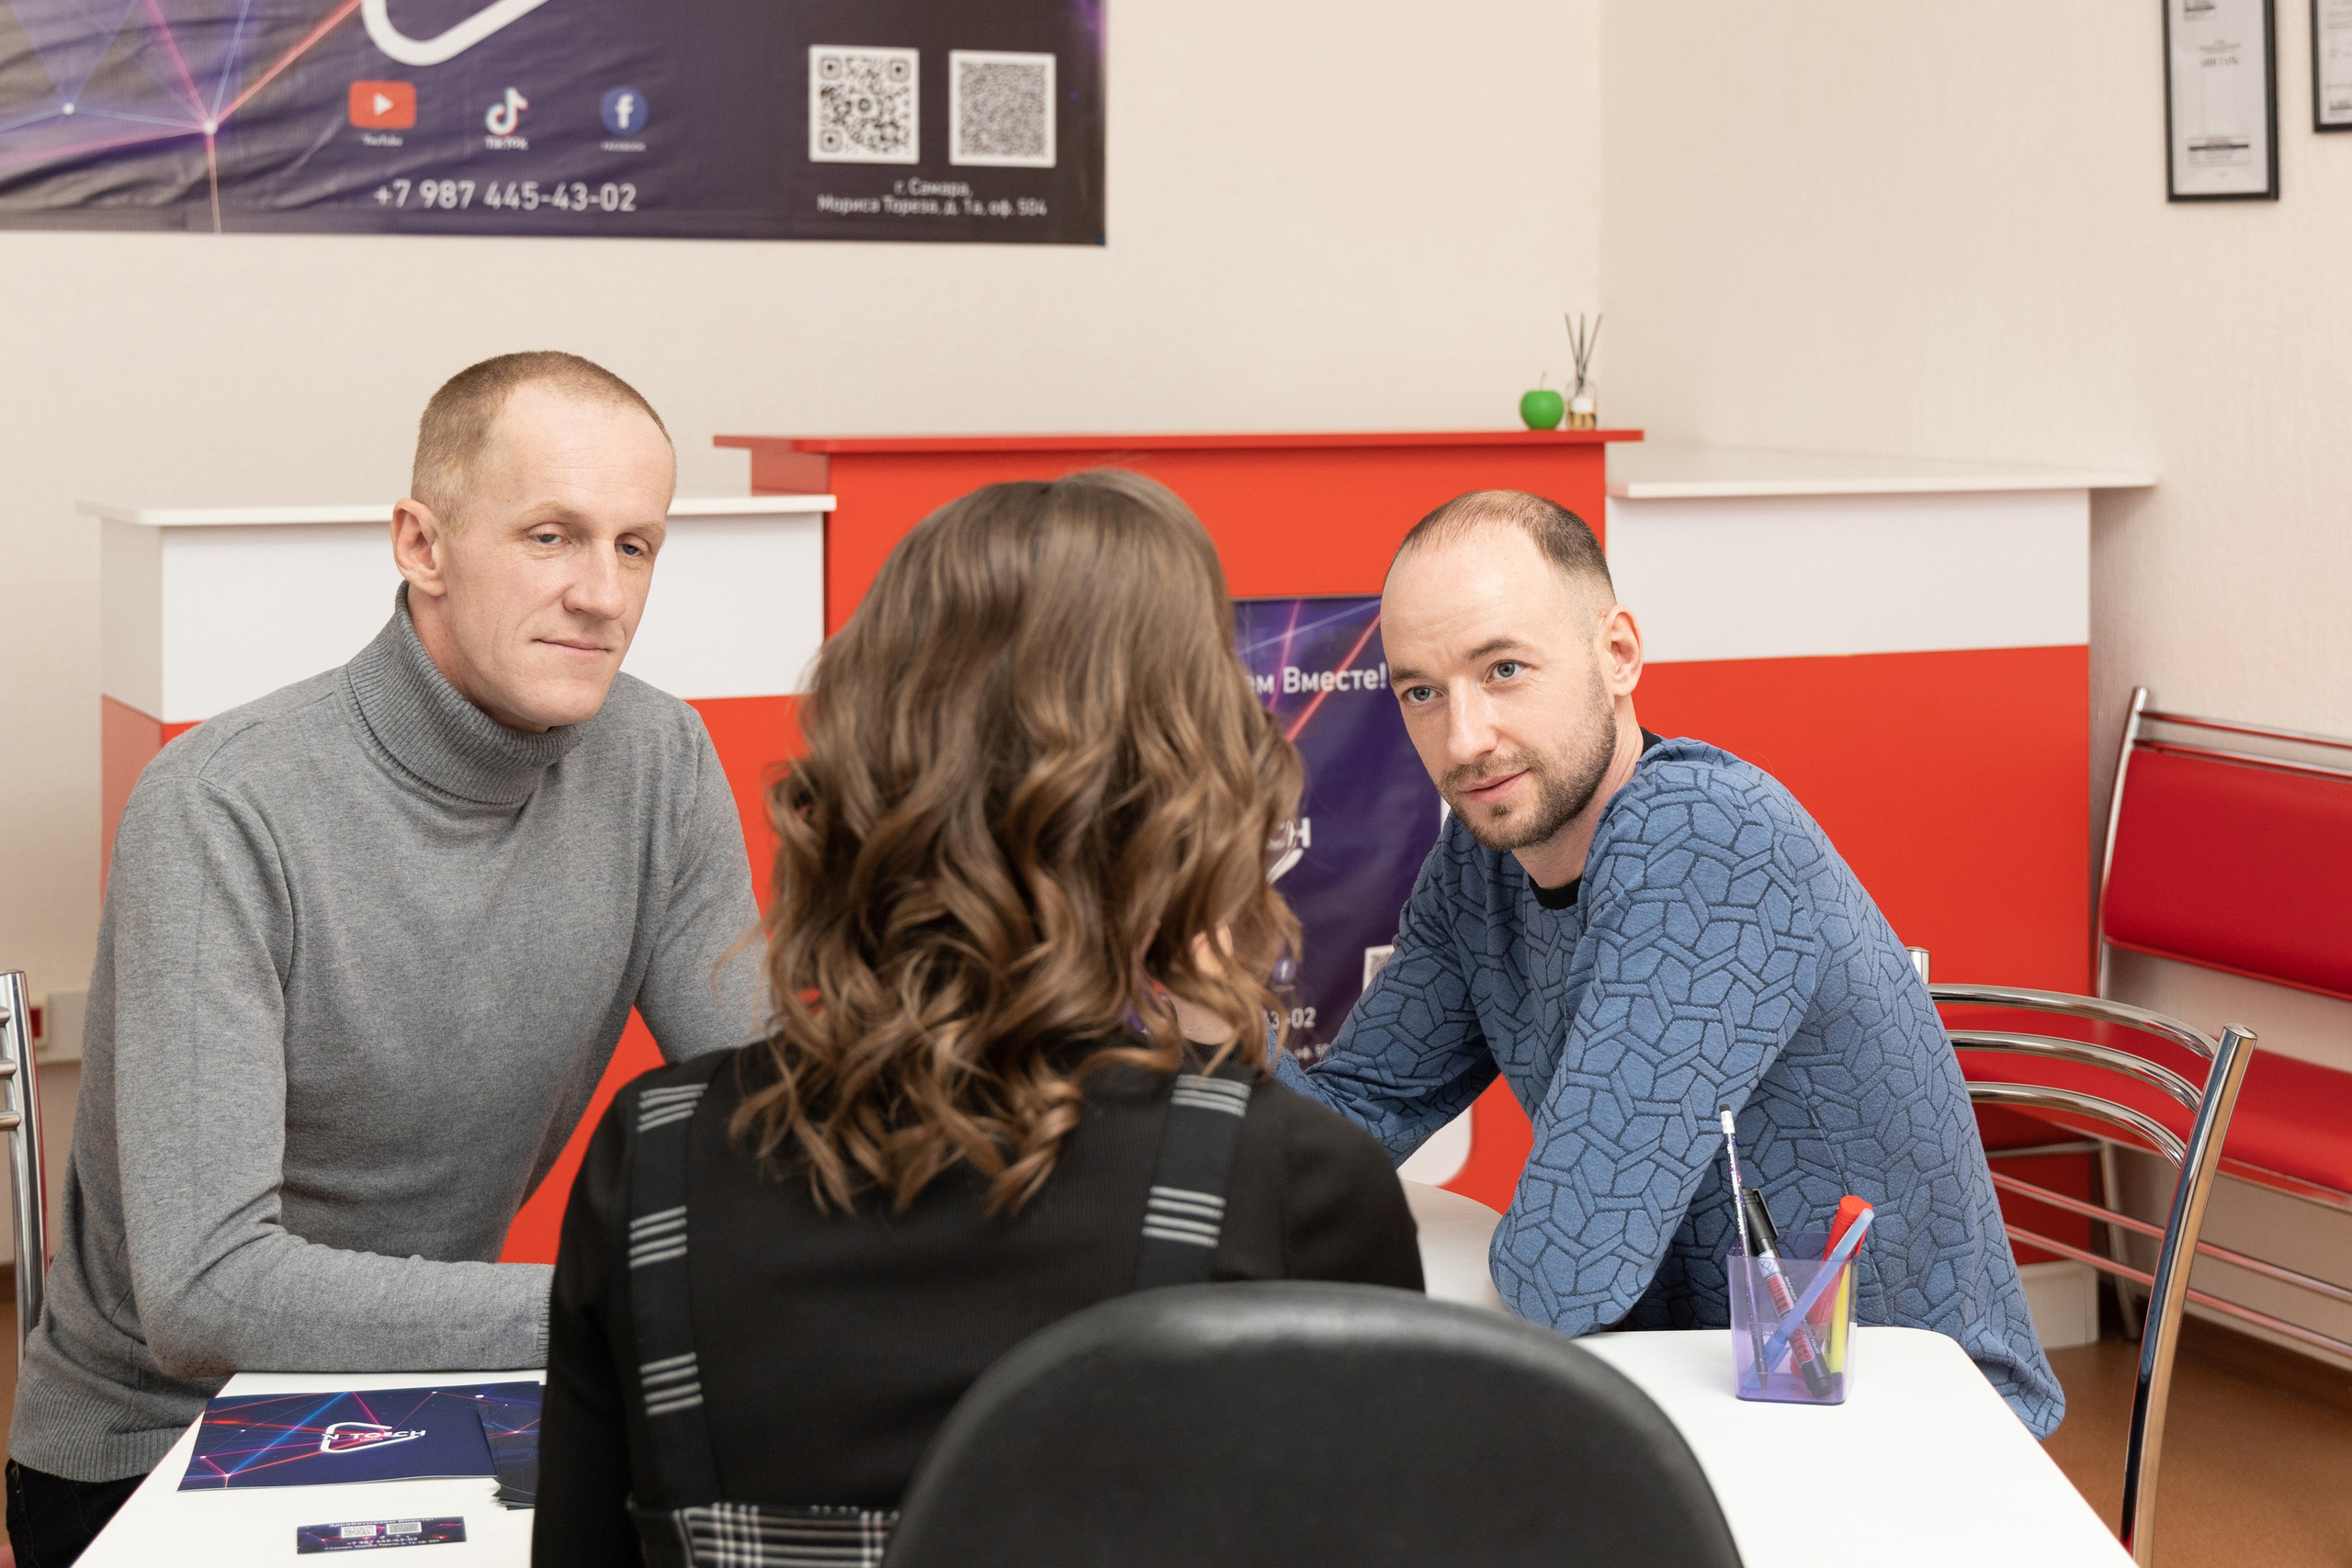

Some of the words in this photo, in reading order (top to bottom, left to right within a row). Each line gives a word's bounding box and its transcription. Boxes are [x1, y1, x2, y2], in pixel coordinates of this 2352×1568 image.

[373, 180, 412, 208] +7
[420, 180, 476, 209] 987
[483, 181, 638, 212] 445-43-02
[908, 176, 973, 199] Самара,
[817, 194, 881, 216] Мориса
[1283, 661, 1387, 694] Вместе!
